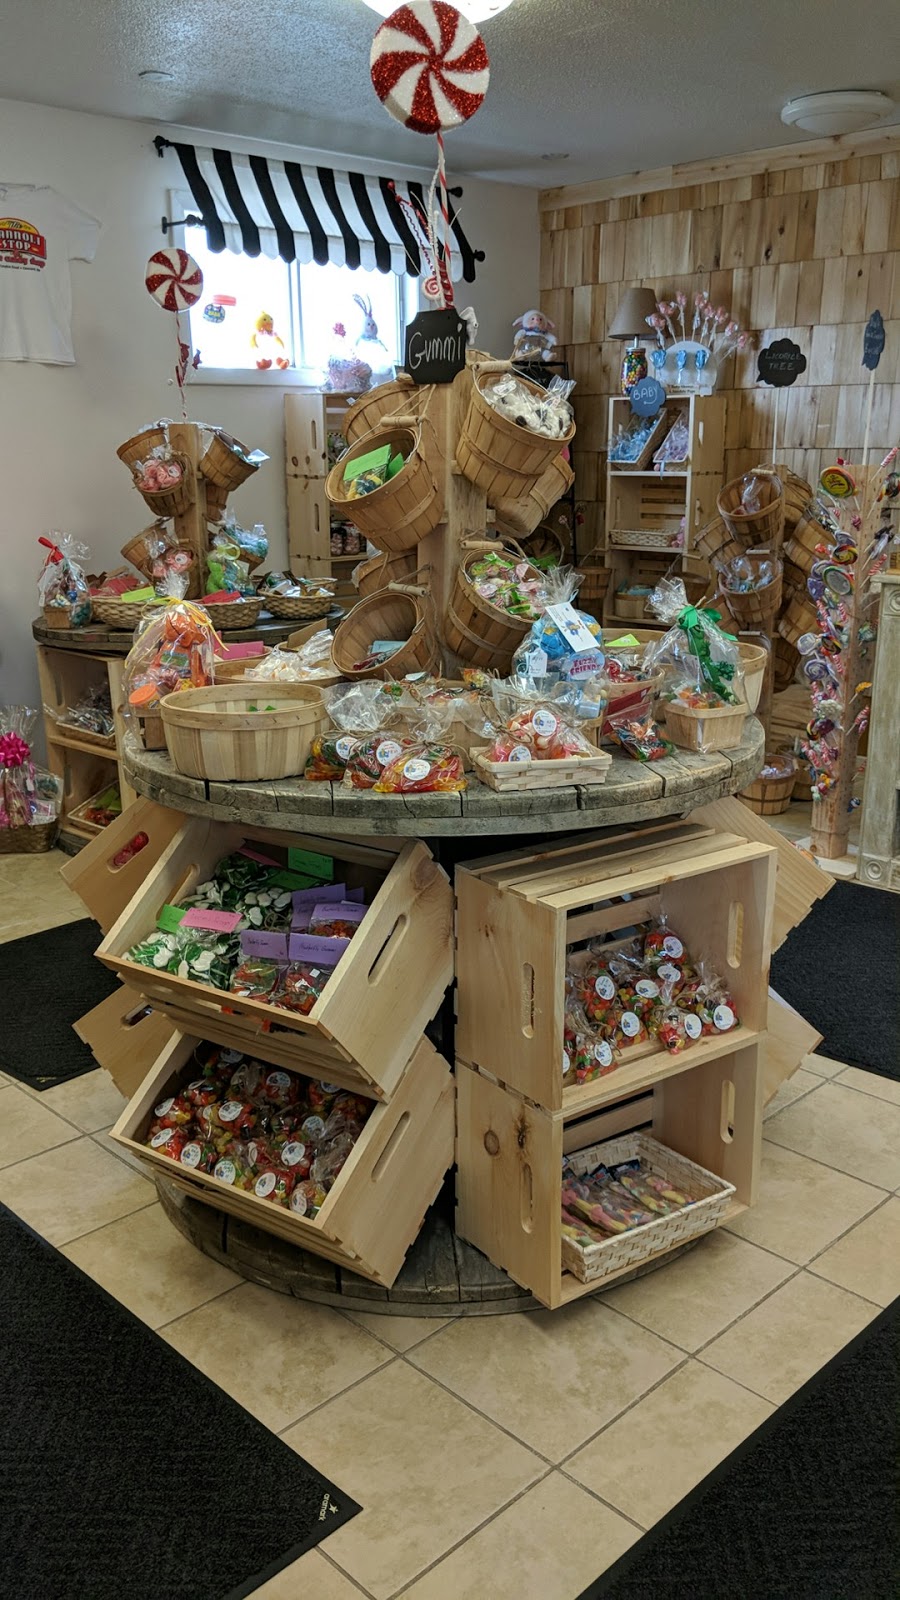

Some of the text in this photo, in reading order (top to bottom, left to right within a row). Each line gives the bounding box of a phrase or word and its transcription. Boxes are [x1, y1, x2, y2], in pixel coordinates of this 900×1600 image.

[2, 239, 31, 251] STOP
[408, 322, 463, 370] Gummi
[769, 361, 794, 371] TREE
[633, 386, 658, 405] BABY
